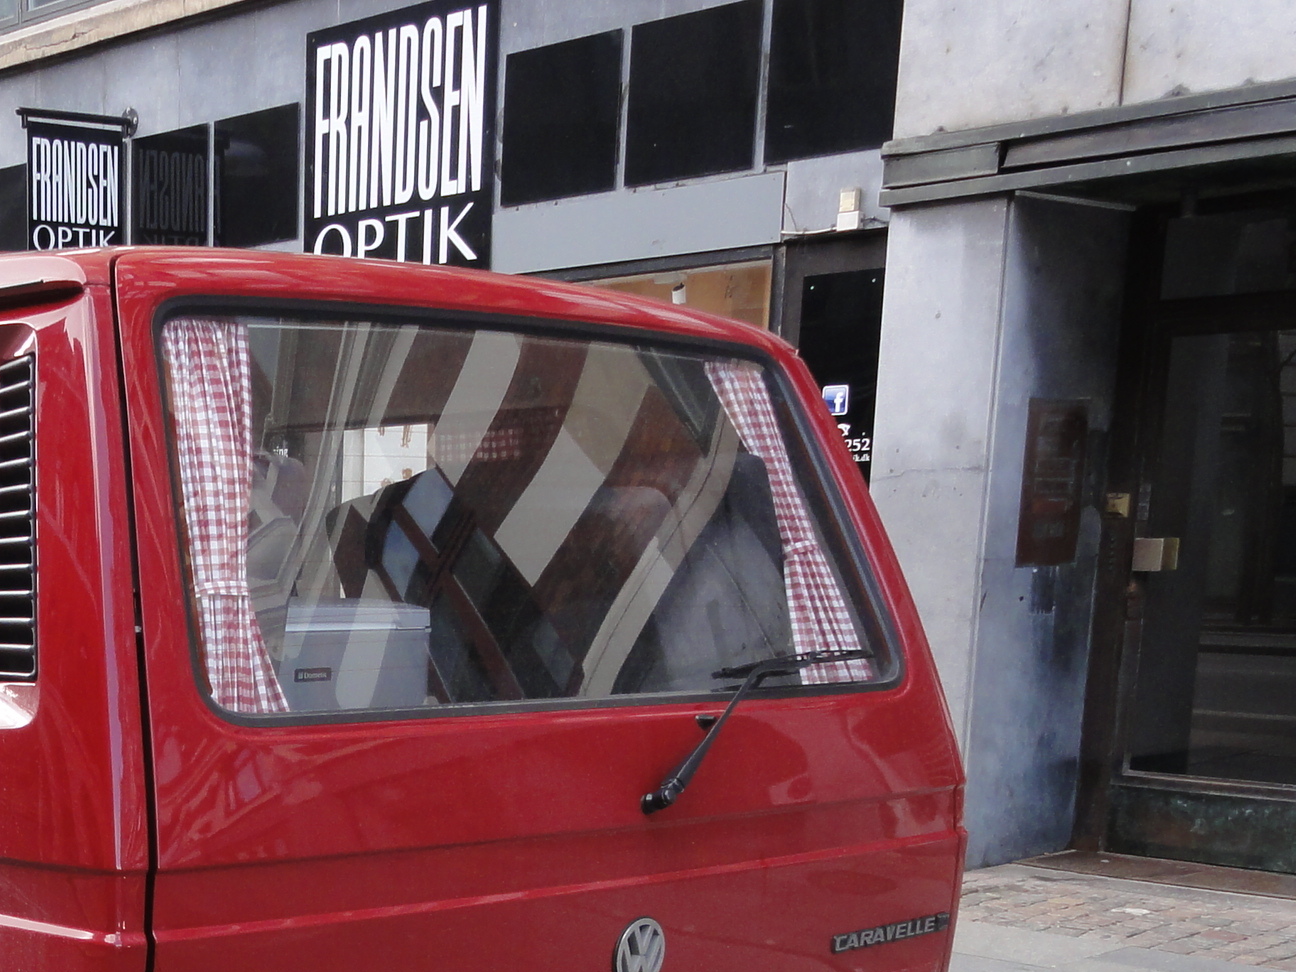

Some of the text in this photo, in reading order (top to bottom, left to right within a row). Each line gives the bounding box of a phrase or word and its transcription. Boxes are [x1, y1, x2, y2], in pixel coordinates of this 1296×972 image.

[313, 5, 488, 219] FRANDSEN
[32, 136, 118, 227] FRANDSEN
[33, 224, 115, 250] OPTIK
[313, 202, 478, 265] OPTIK
[833, 916, 936, 952] CARAVELLE
